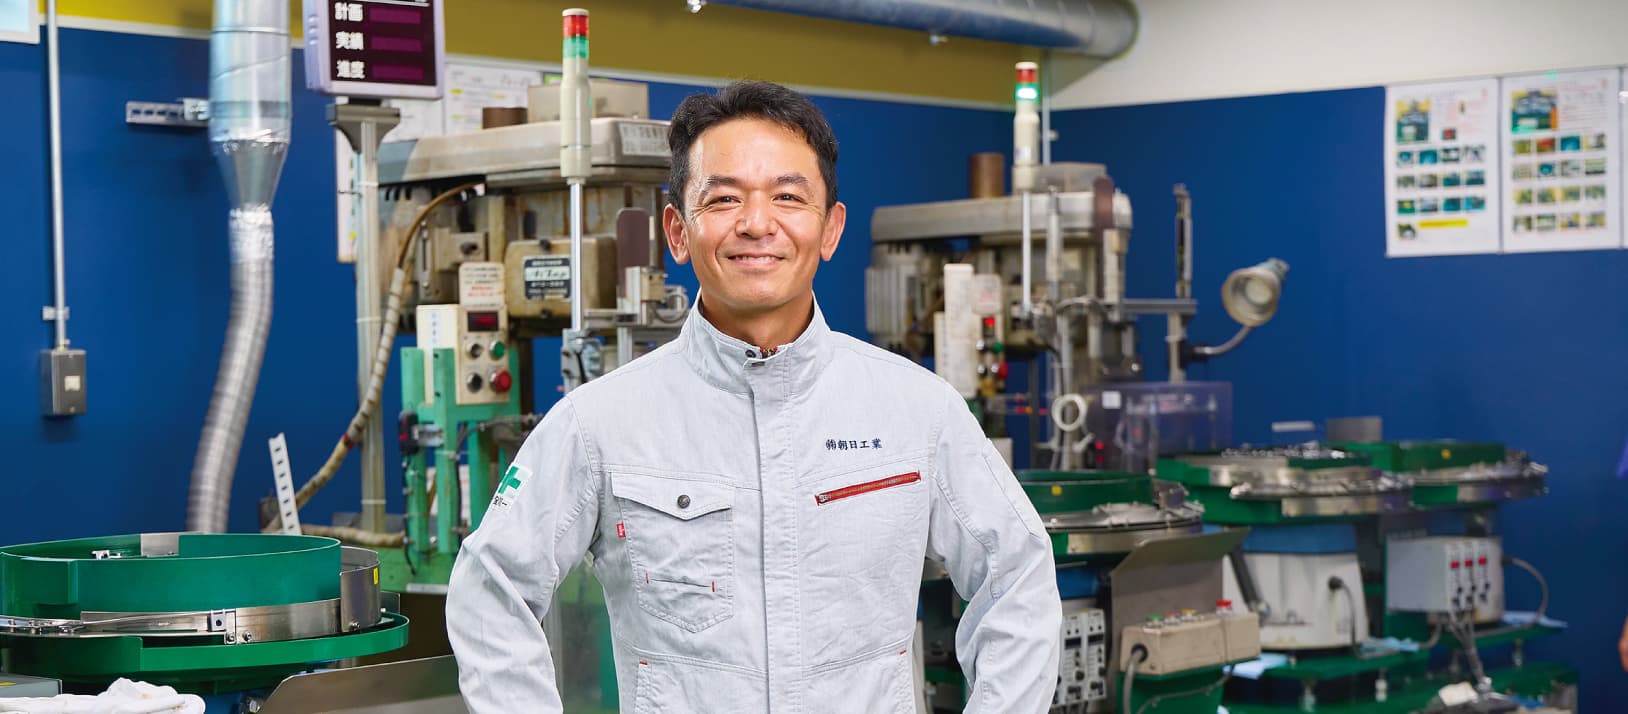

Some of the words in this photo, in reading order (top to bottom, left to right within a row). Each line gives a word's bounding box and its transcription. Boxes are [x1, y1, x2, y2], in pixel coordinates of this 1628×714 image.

[334, 2, 363, 22] 計画
[335, 31, 364, 50] 実績
[336, 59, 365, 79] 進度
